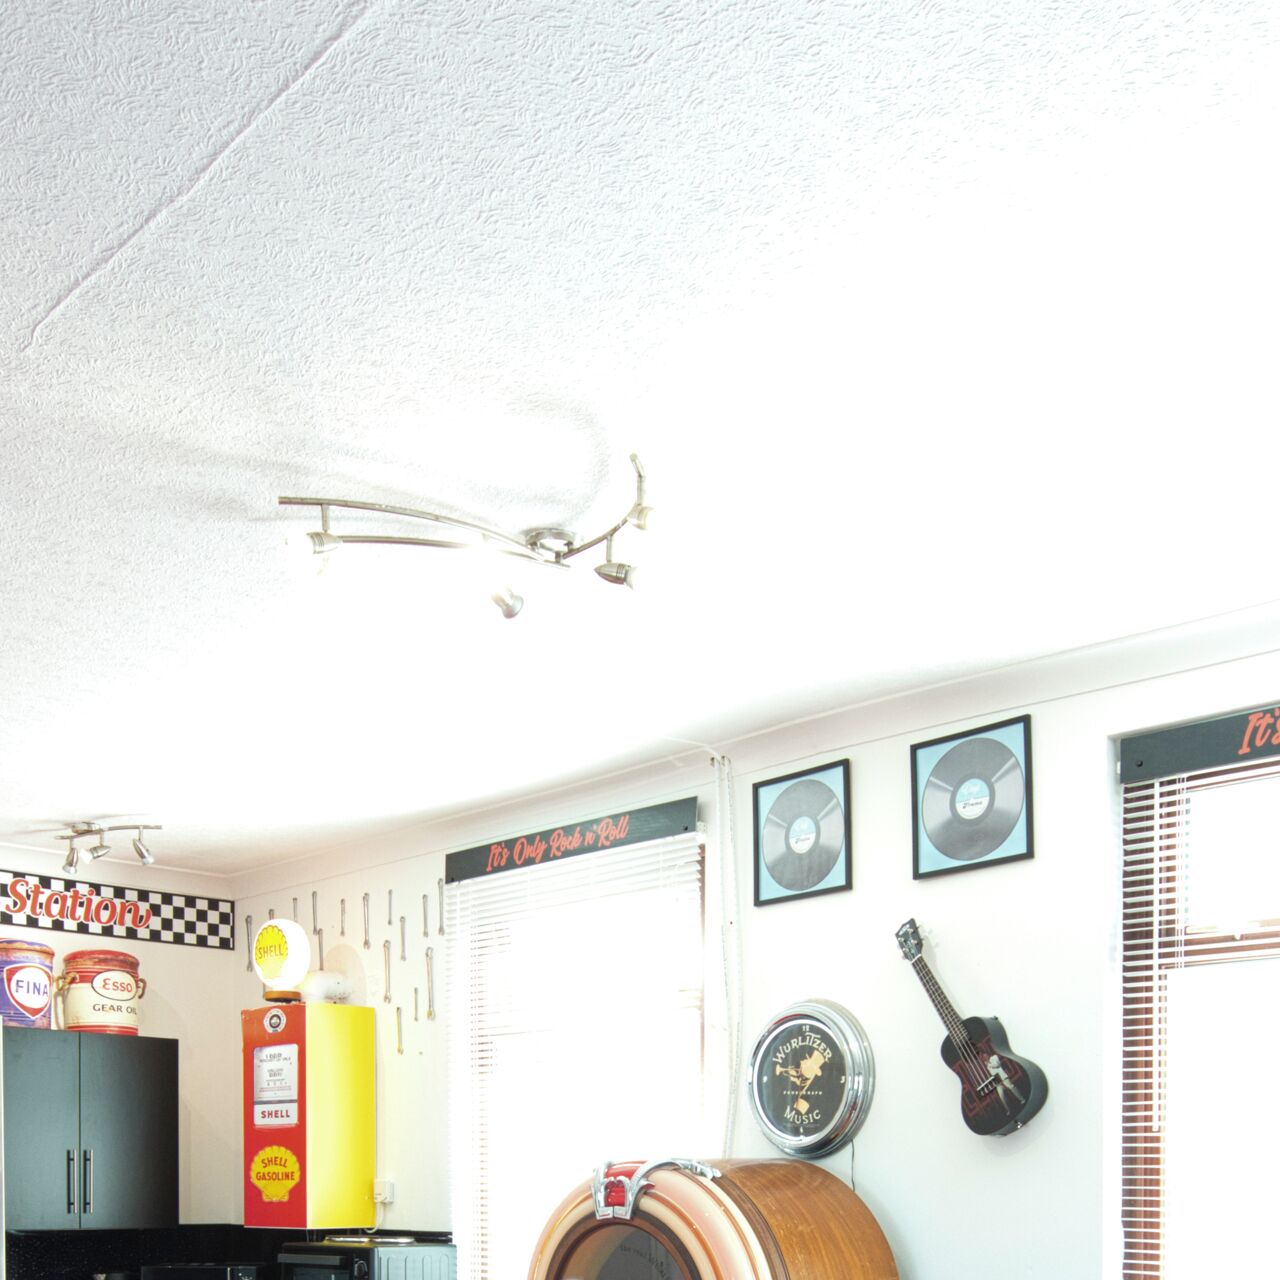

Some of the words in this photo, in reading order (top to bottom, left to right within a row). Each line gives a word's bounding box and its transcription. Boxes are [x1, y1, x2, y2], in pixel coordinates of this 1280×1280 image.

[486, 842, 510, 872] It's
[513, 834, 547, 865] Only
[549, 827, 583, 858] Rock
[5, 877, 153, 929] Station
[258, 944, 284, 960] SHELL
[15, 979, 49, 997] FINA
[92, 1003, 124, 1013] GEAR
[772, 1032, 833, 1063] WURLITZER
[260, 1109, 291, 1119] SHELL
[784, 1105, 821, 1124] MUSIC
[261, 1156, 288, 1168] SHELL
[255, 1171, 296, 1181] GASOLINE
